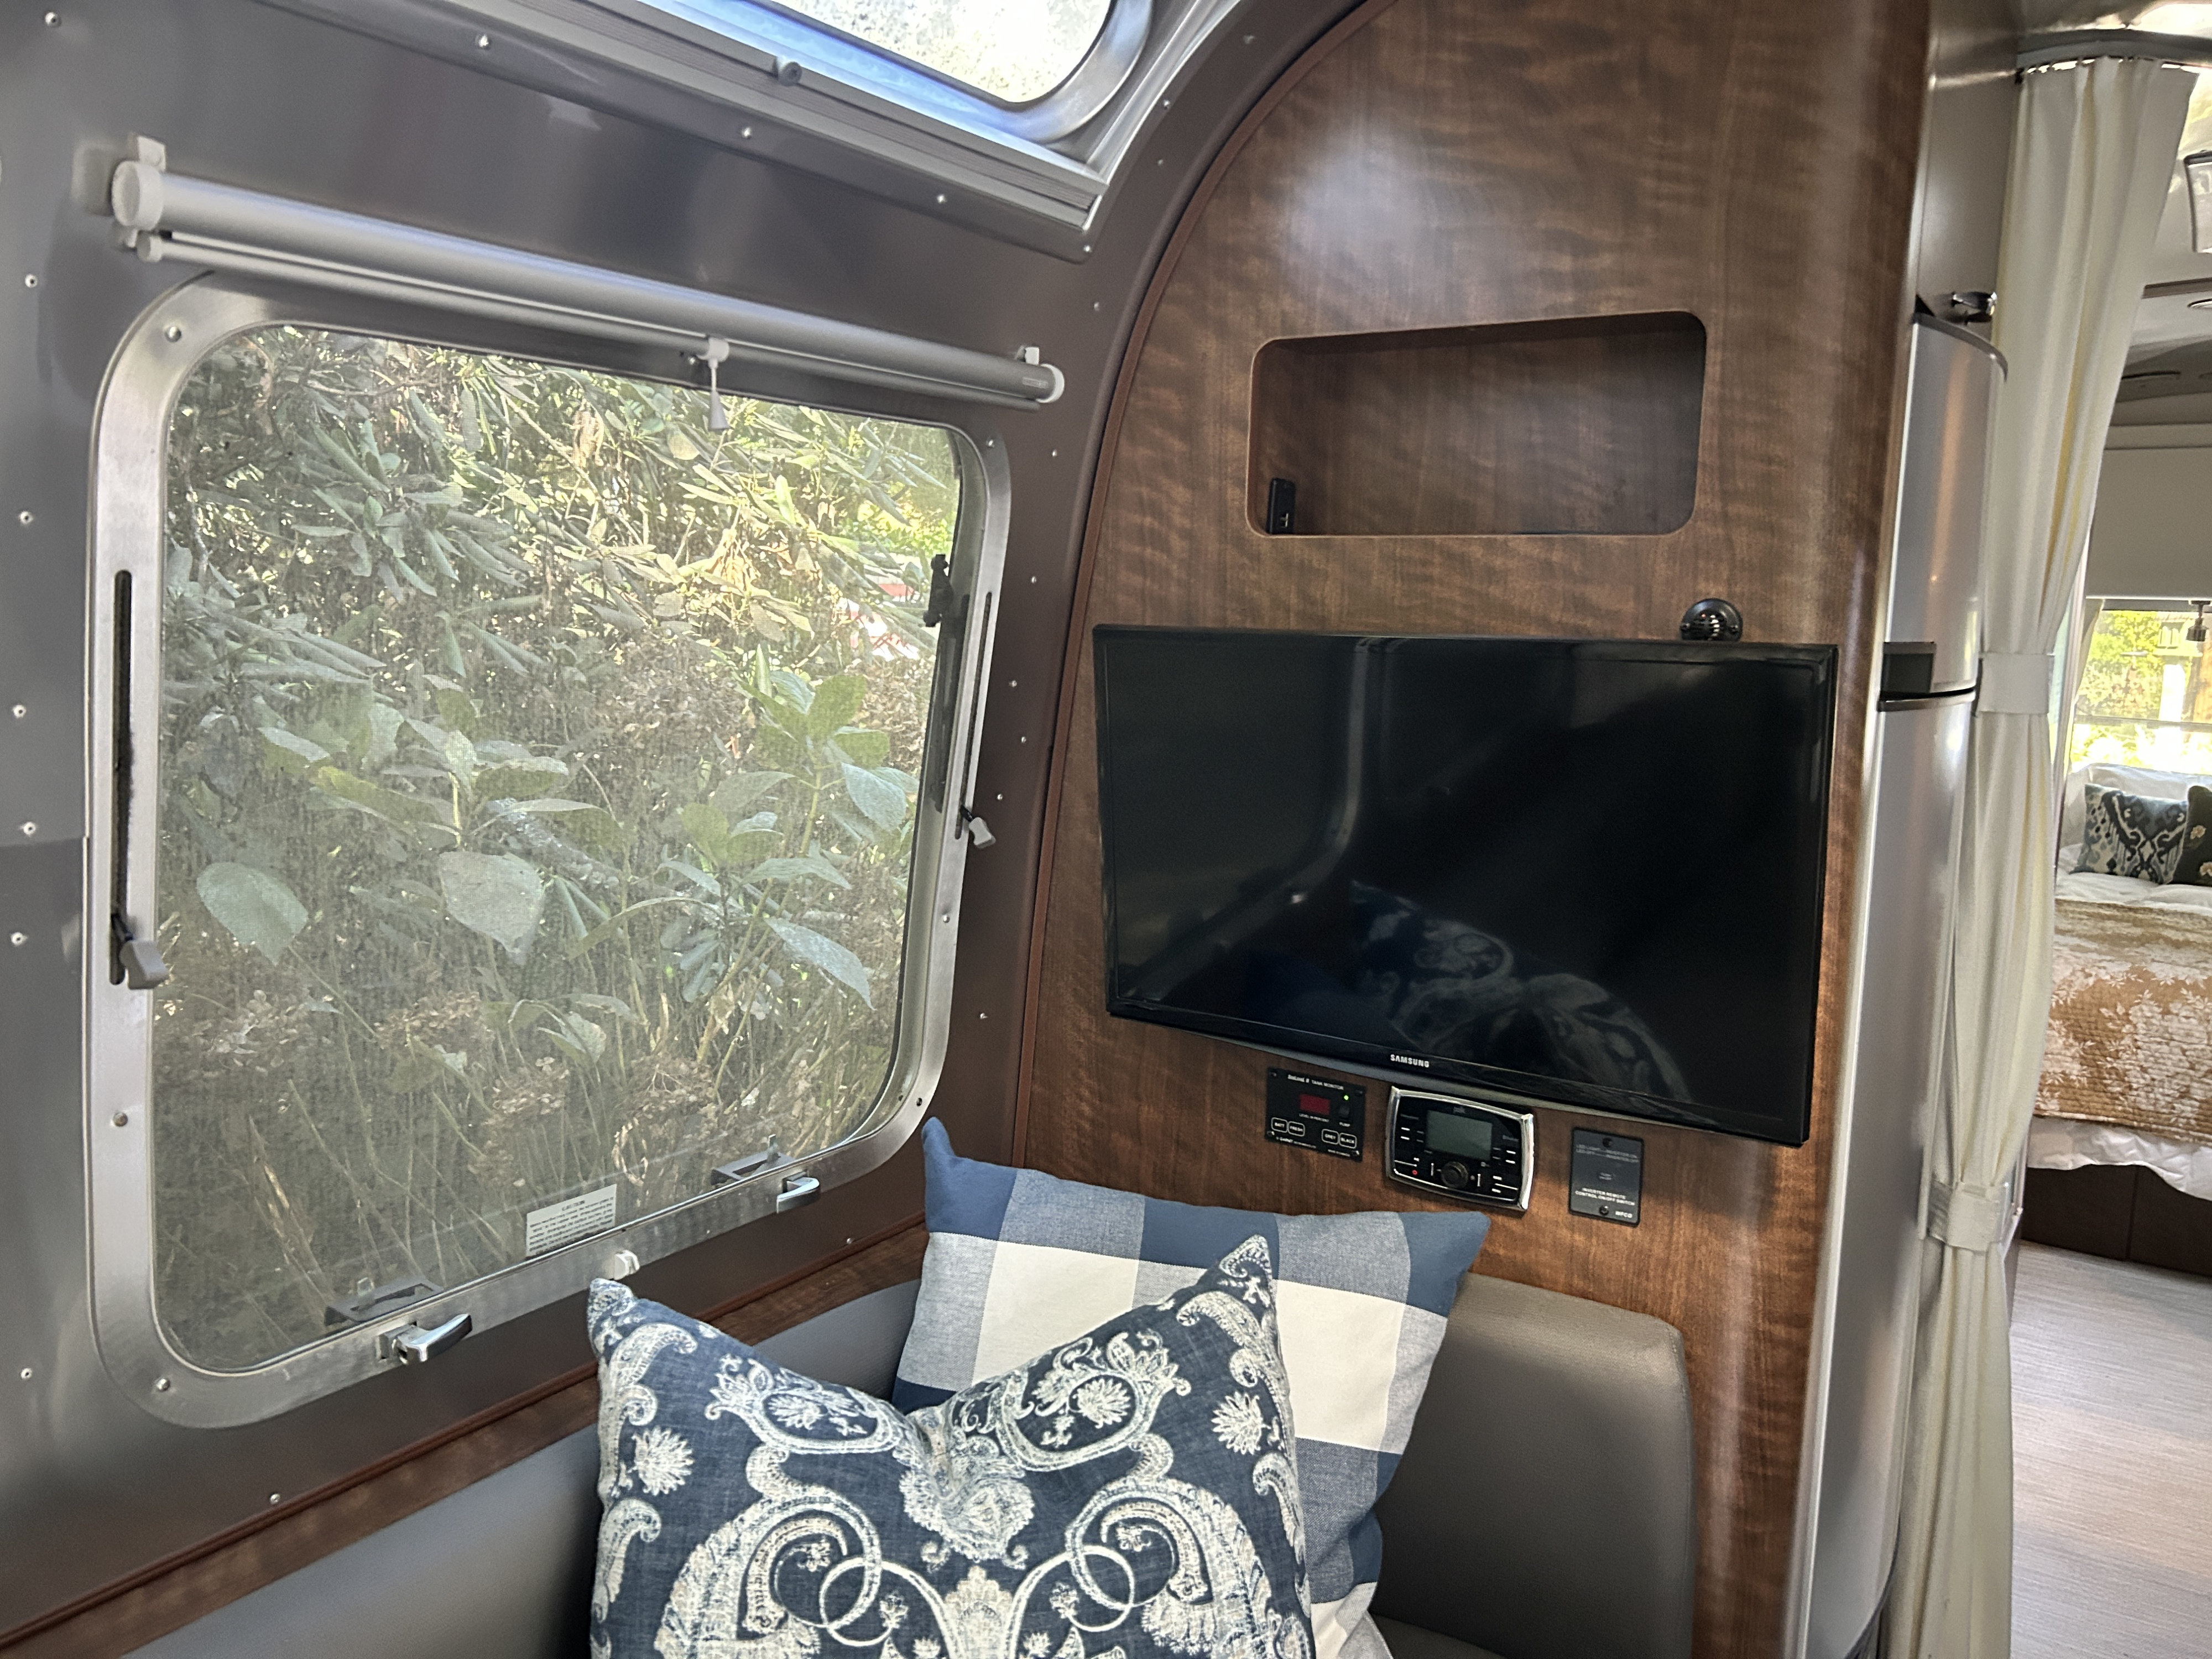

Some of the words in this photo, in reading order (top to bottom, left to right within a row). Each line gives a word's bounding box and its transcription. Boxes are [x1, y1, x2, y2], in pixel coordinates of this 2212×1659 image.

[1390, 1054, 1430, 1068] SAMSUNG
[1323, 1082, 1344, 1091] MONITOR
[1575, 1190, 1597, 1199] CONTROL
[1606, 1192, 1626, 1200] REMOTE
